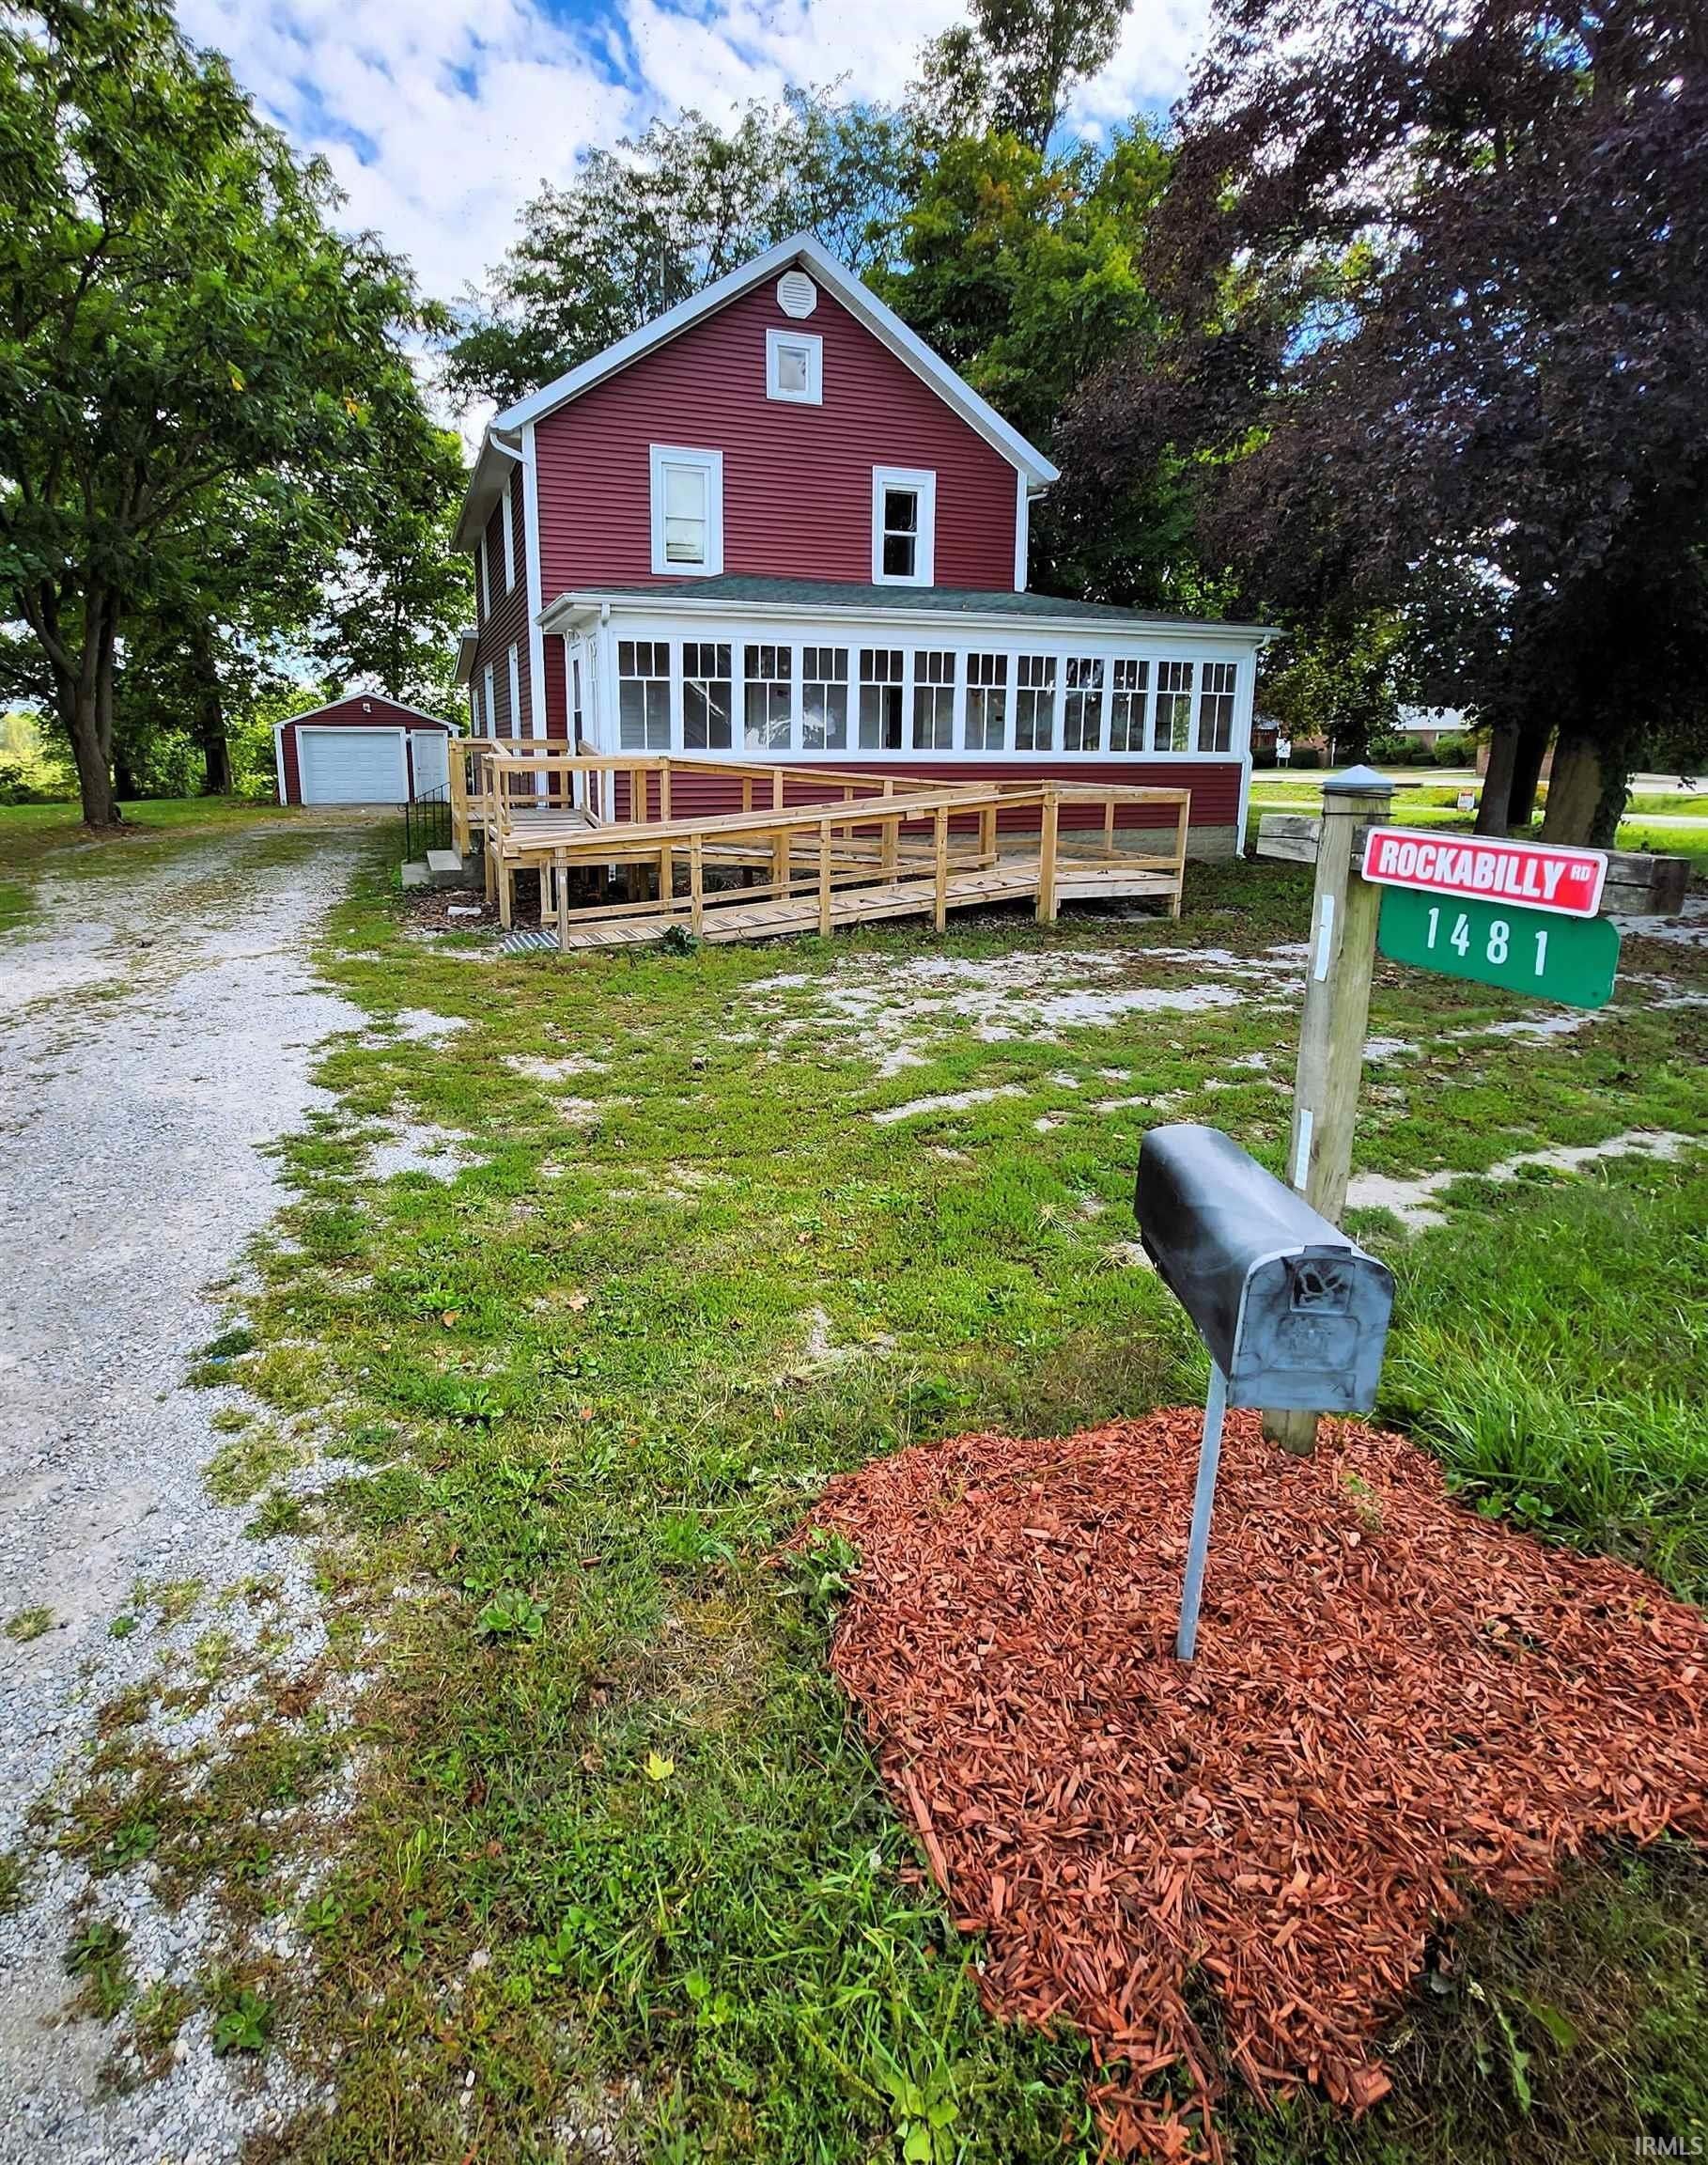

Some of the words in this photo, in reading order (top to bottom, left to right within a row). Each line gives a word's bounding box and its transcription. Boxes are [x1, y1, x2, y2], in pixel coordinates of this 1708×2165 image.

[1378, 840, 1566, 900] ROCKABILLY
[1570, 864, 1591, 881] RD
[1427, 907, 1548, 976] 1481
